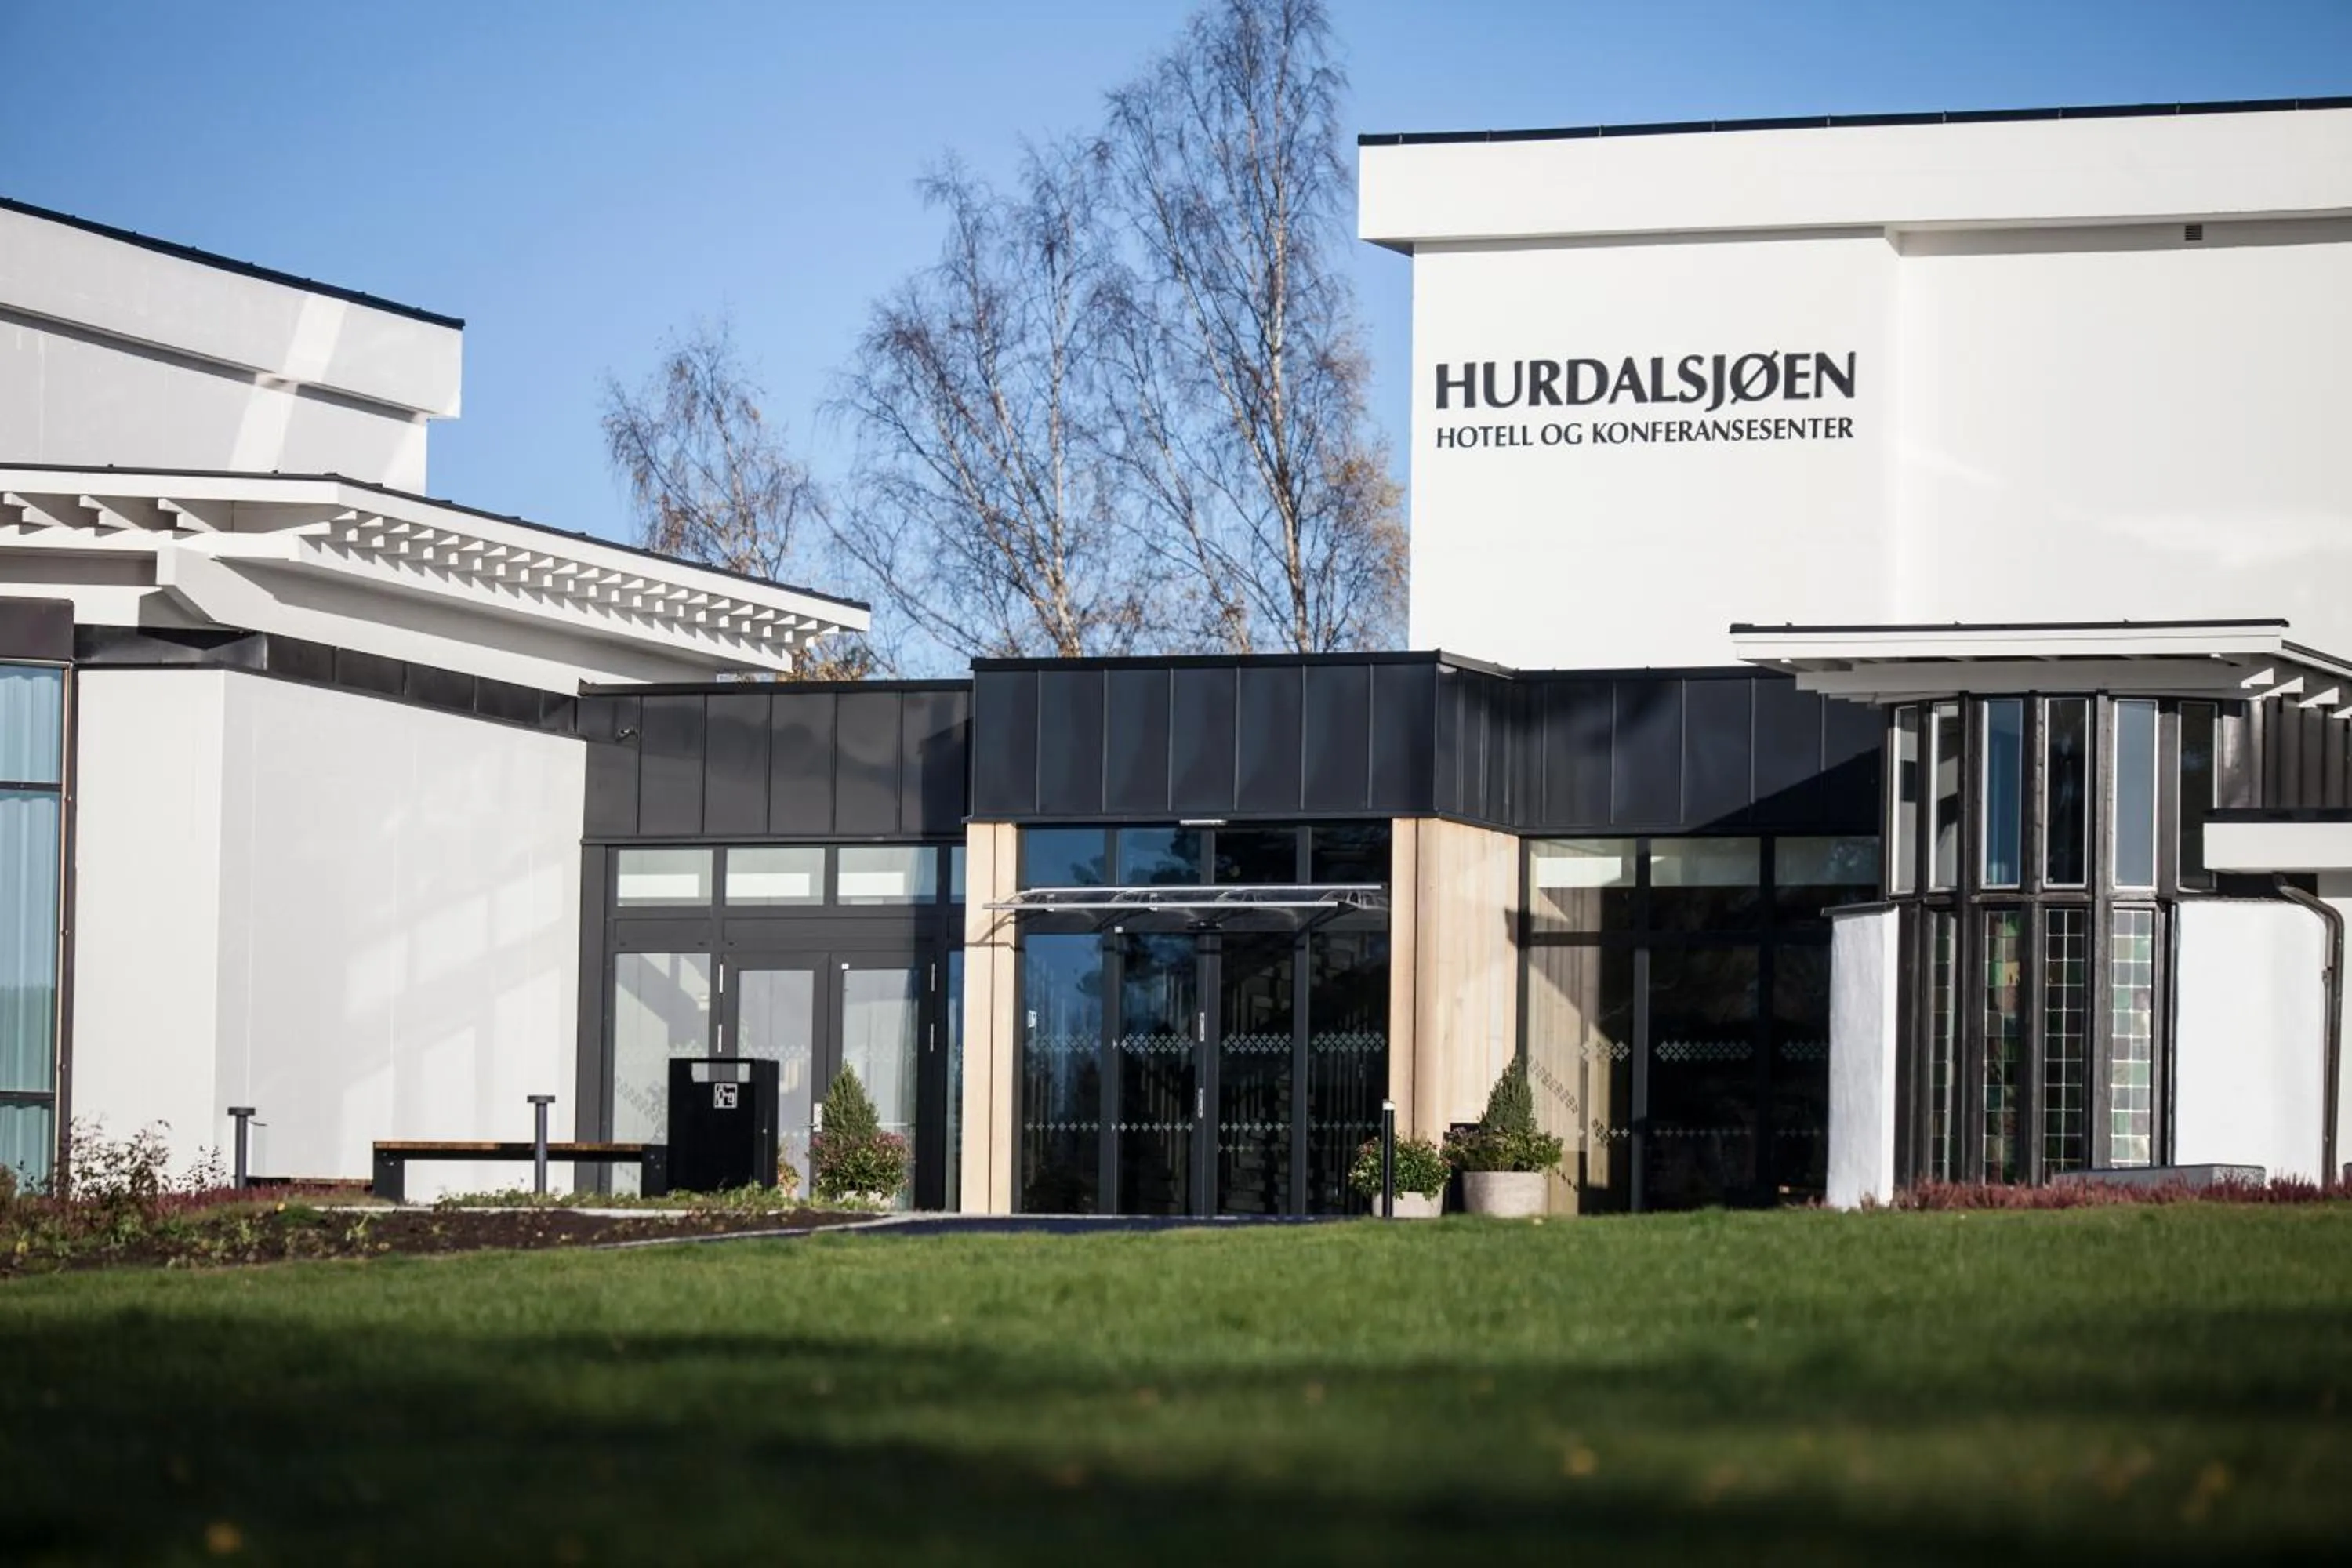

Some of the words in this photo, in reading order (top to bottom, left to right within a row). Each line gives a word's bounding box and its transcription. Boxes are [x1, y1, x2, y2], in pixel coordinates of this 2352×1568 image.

[1436, 350, 1856, 412] HURDALSJØEN
[1437, 425, 1533, 448] HOTELL
[1541, 423, 1582, 445] OG
[1593, 417, 1853, 444] KONFERANSESENTER
